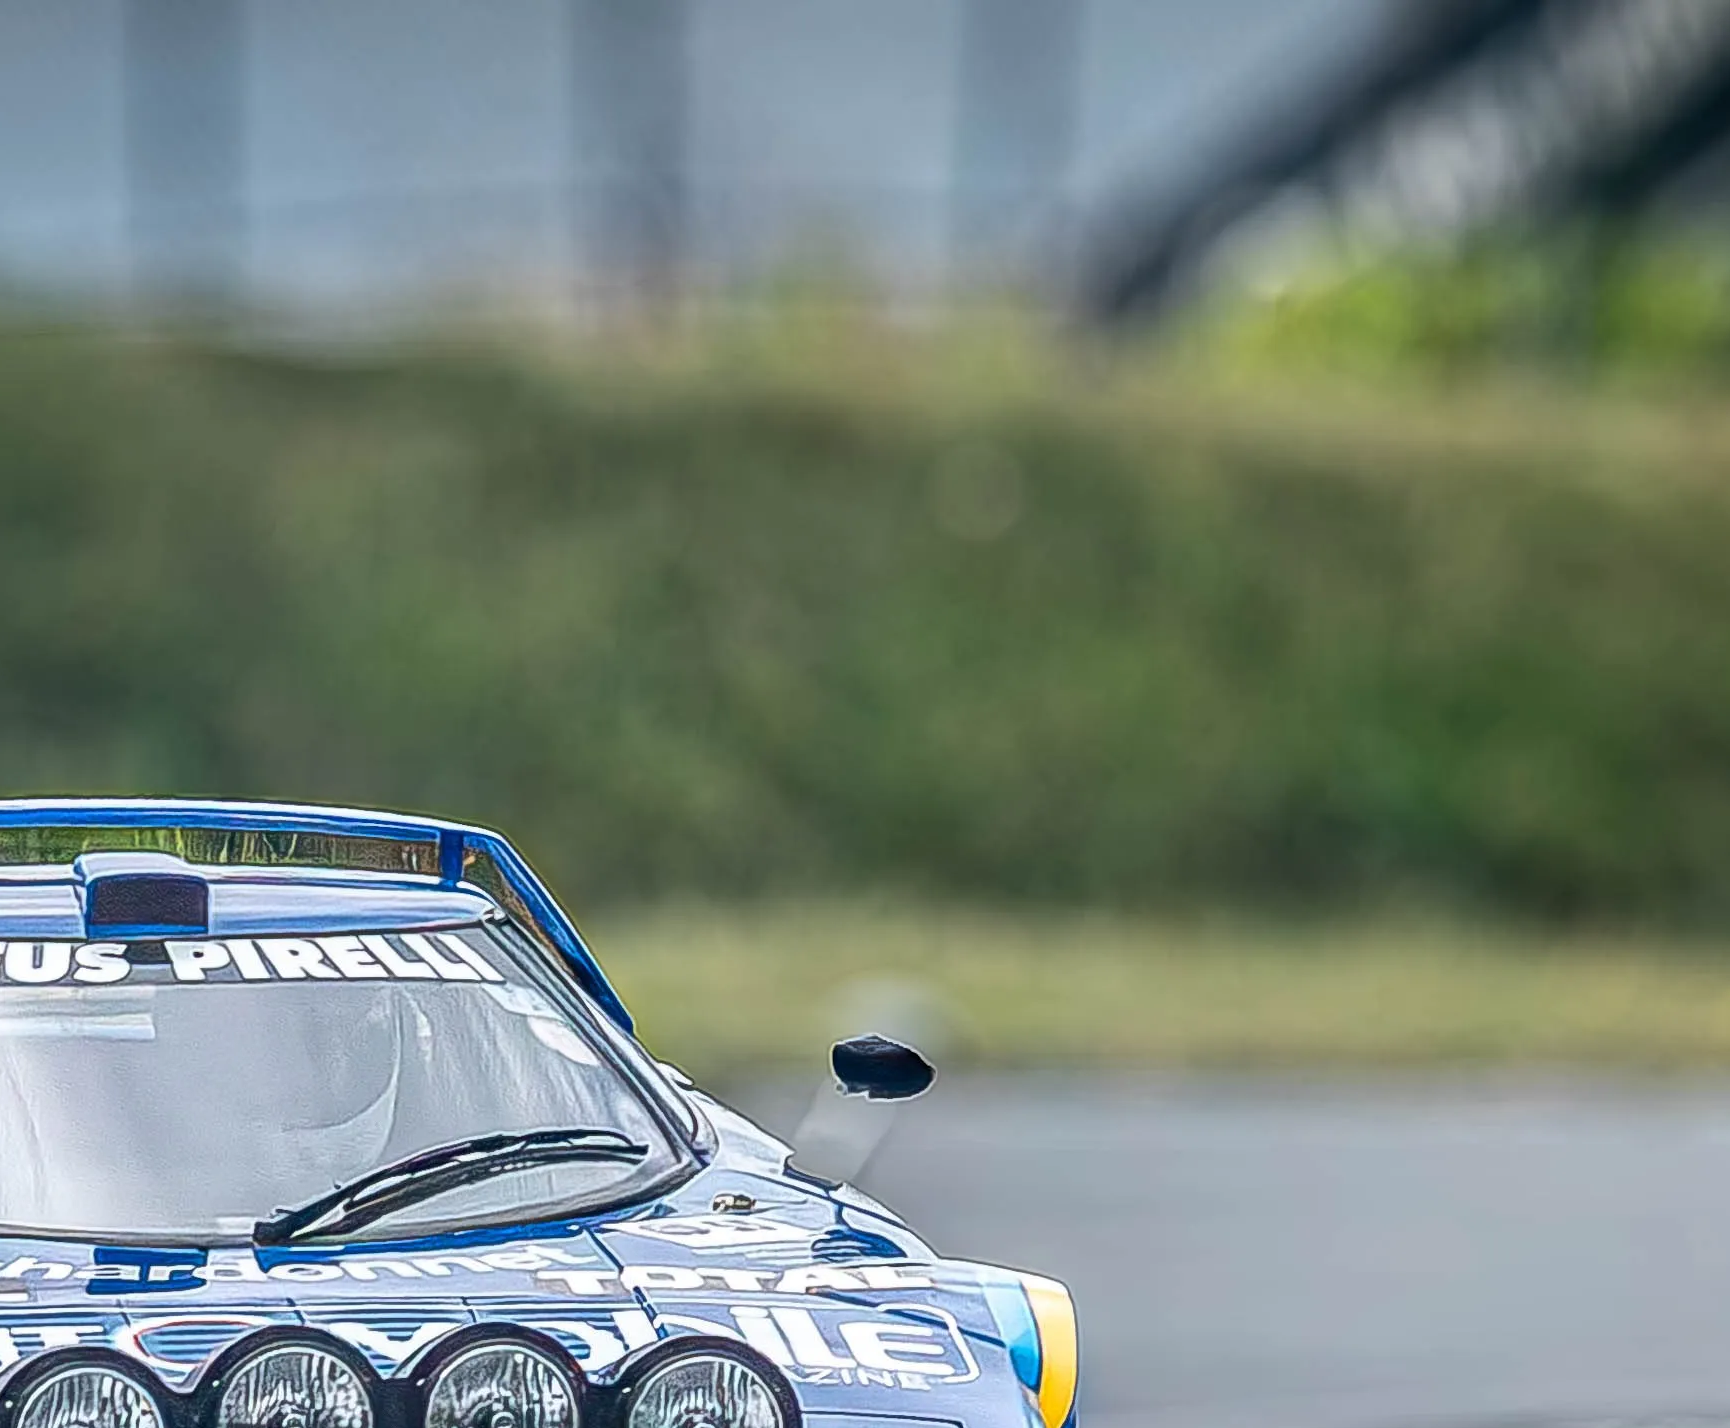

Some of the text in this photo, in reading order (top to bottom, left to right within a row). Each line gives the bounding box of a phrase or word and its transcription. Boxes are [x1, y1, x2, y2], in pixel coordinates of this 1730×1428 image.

[165, 931, 506, 984] PIRELLI
[535, 1264, 937, 1296] TOTAL
[804, 1367, 932, 1392] ZINE
